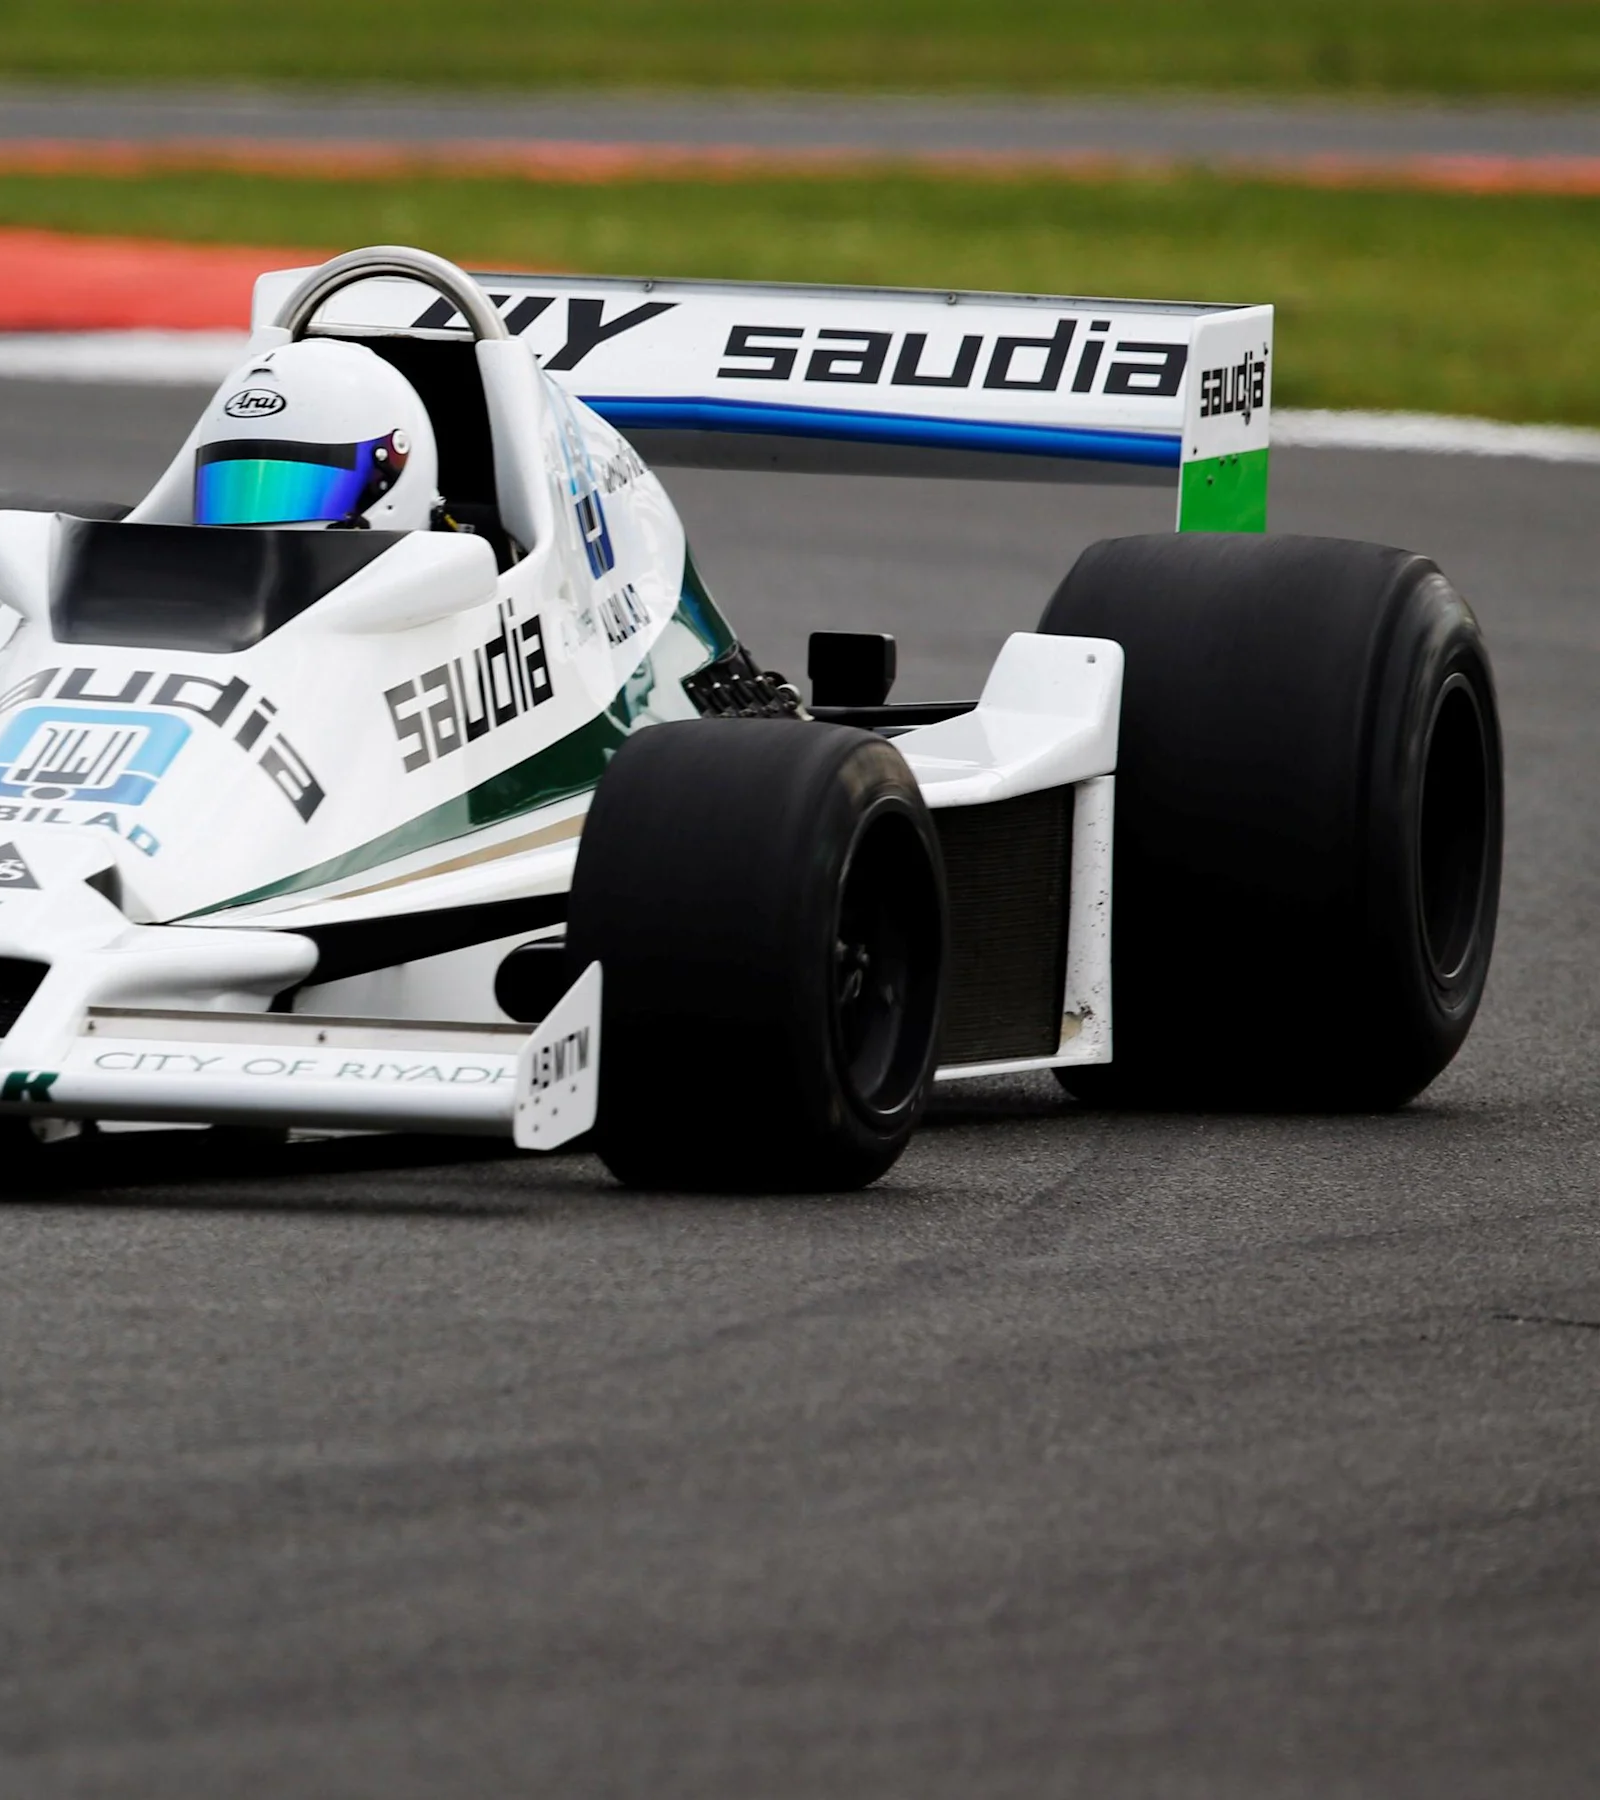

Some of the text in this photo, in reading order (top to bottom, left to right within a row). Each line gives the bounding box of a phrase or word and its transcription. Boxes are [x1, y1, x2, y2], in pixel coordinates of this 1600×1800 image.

[716, 319, 1188, 397] saudia
[1200, 350, 1266, 418] saudia
[226, 392, 278, 409] Arai
[384, 597, 554, 773] saudia
[94, 1052, 223, 1073] CITY
[242, 1059, 317, 1077] OF
